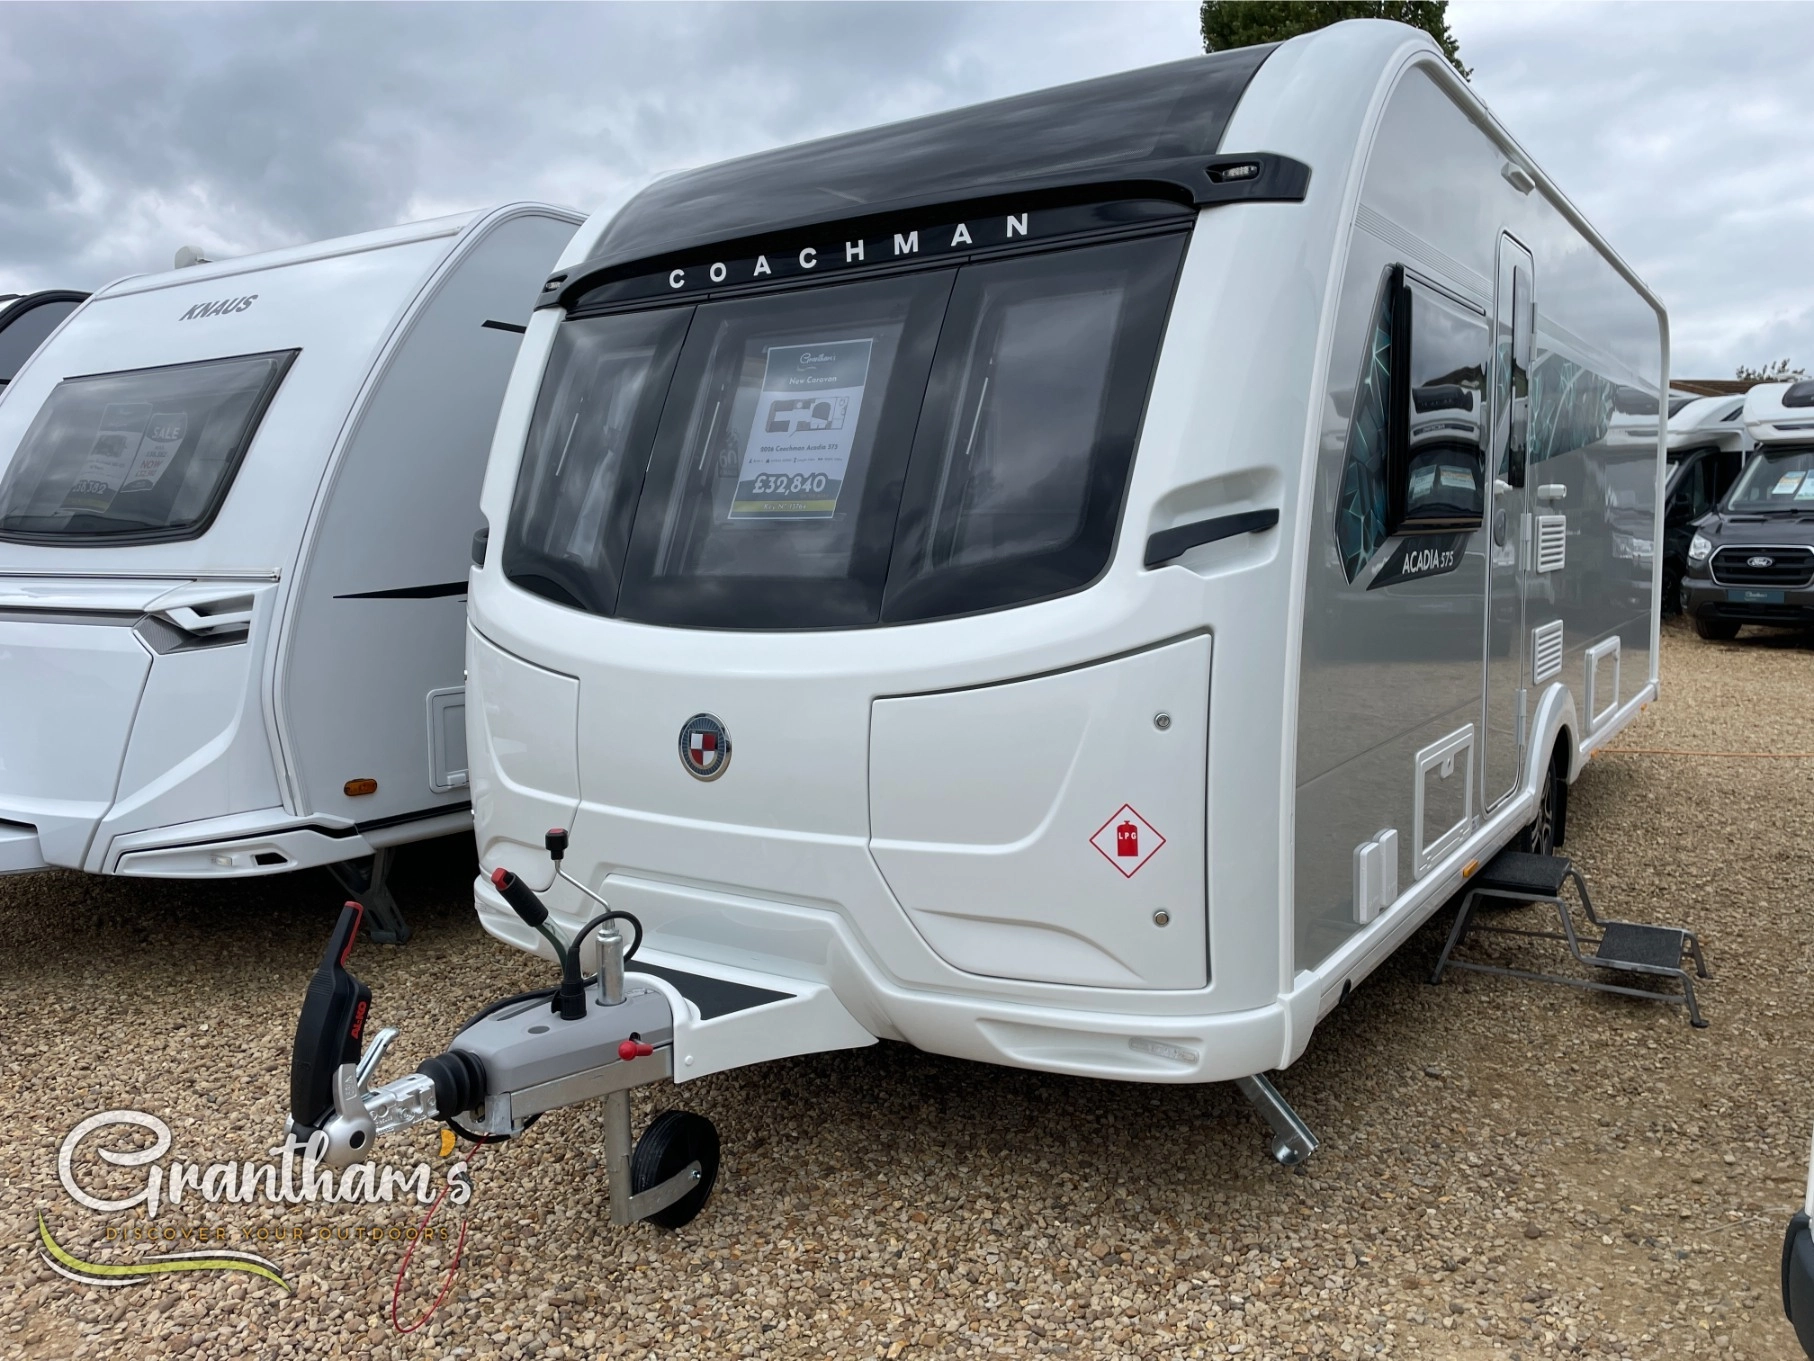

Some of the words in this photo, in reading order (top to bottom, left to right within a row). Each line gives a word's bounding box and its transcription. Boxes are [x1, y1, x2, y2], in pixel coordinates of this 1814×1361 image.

[669, 213, 1028, 289] COACHMAN
[178, 294, 259, 322] KNAUS
[806, 376, 837, 384] Caravan
[152, 426, 180, 439] SALE
[752, 475, 826, 495] £32,840
[1402, 549, 1439, 574] ACADIA
[1440, 551, 1454, 568] 575
[1118, 832, 1137, 840] LPG
